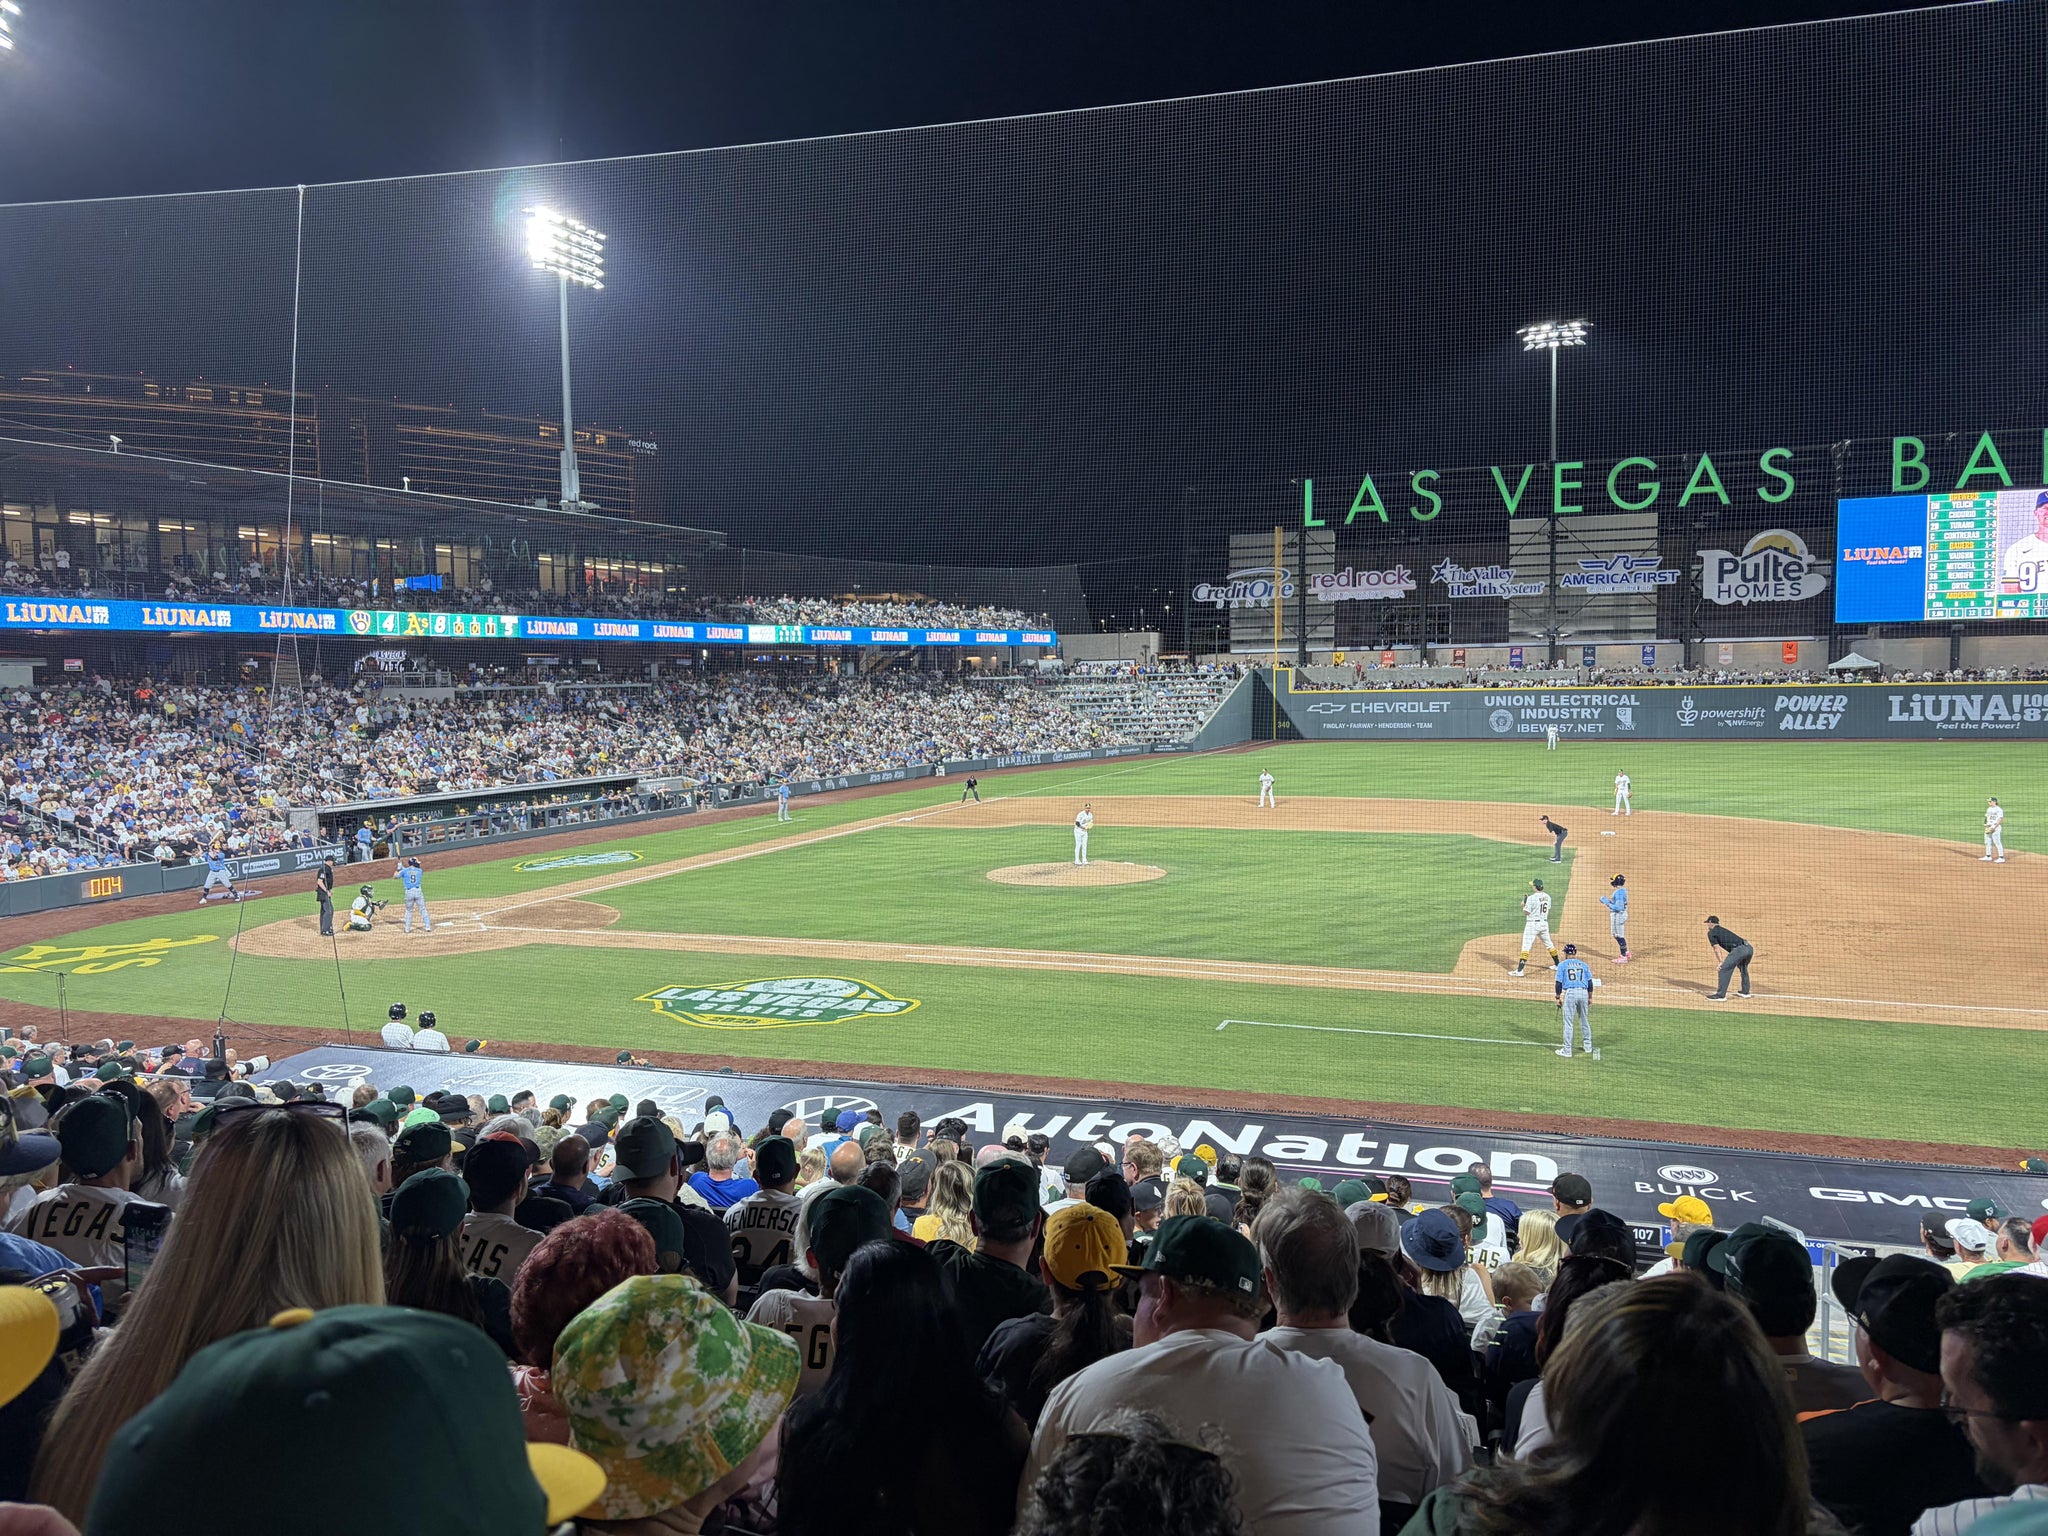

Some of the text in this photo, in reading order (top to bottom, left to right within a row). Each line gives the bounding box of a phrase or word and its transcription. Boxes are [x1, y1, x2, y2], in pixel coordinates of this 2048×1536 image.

[1305, 469, 1443, 527] LAS
[1490, 447, 1796, 518] VEGAS
[1843, 546, 1908, 561] LiUNA!
[1472, 567, 1514, 582] Valley
[1717, 552, 1805, 584] Pulte
[1312, 565, 1411, 588] red rock
[1561, 571, 1679, 585] AMERICA FIRST
[2019, 561, 2037, 592] 9
[1450, 584, 1542, 598] Health System
[1717, 582, 1802, 599] HOMES
[6, 603, 92, 624] LiUNA!
[93, 613, 109, 624] 872
[142, 606, 216, 627] LiUNA!
[259, 611, 323, 630] LiUNA!
[382, 614, 395, 632] 4
[435, 614, 446, 634] 8
[527, 620, 570, 635] LiUNA!
[594, 623, 632, 636] LiUNA!
[653, 625, 684, 638] LiUNA!
[706, 627, 737, 639] LiUNA!
[811, 629, 844, 641] LiUNA!
[1350, 701, 1451, 713] CHEVROLET
[1484, 694, 1640, 706] UNION ELECTRICAL
[1774, 694, 1848, 712] POWER
[1888, 693, 2048, 722] LiUNA! LO
[1520, 708, 1601, 719] INDUSTRY
[1700, 706, 1766, 720] powershift
[1277, 721, 1290, 729] 340
[1779, 713, 1842, 731] ALLEY
[997, 754, 1041, 768] HANRATTY
[295, 851, 313, 862] TED
[410, 874, 416, 883] 9
[1540, 902, 1548, 913] 16
[1568, 968, 1583, 981] 67
[653, 988, 907, 1013] LAS VEGAS
[694, 1003, 824, 1018] SERIES
[919, 1101, 1559, 1181] AutoNation
[1634, 1181, 1757, 1203] BUICK
[1633, 1228, 1654, 1240] 107
